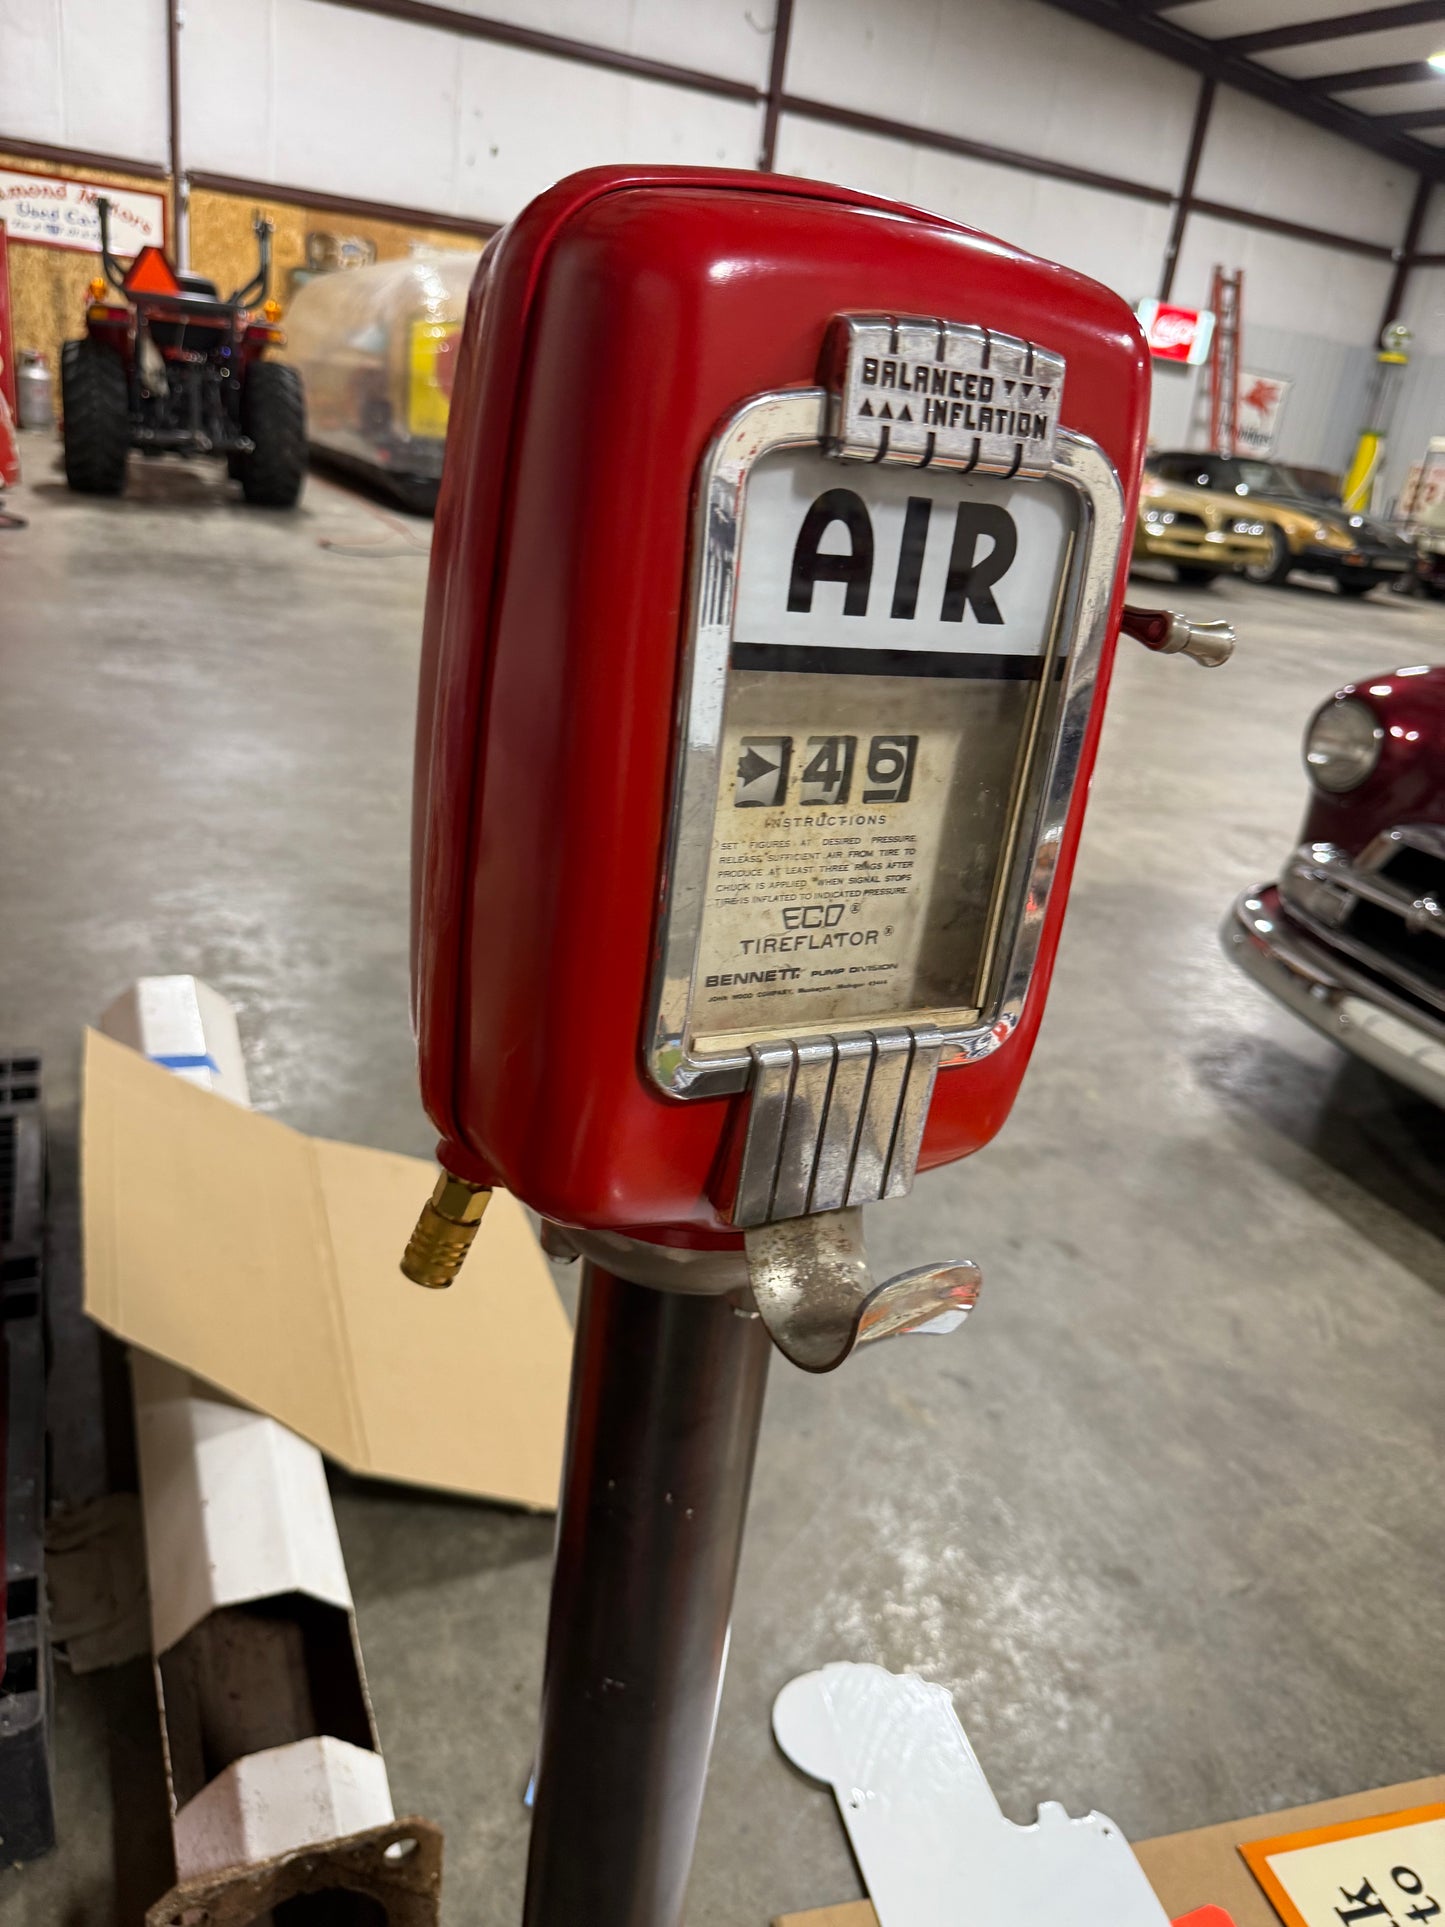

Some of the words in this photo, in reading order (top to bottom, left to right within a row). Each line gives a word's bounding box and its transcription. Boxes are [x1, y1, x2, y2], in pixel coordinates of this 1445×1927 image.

[861, 356, 994, 402] BALANCED
[922, 398, 1047, 440] INFLATION
[786, 488, 1018, 625] AIR
[763, 814, 887, 829] INSTRUCTIONS
[720, 842, 739, 851] SET
[748, 840, 791, 850] FIGURES
[800, 839, 812, 847] AT
[822, 837, 861, 846] DESIRED
[766, 852, 821, 862] SUFFICIENT
[826, 851, 843, 860] AIR
[847, 850, 875, 858] FROM
[879, 848, 900, 857] TIRE
[903, 847, 917, 856] TO
[717, 868, 764, 879] PRODUCE
[768, 867, 782, 877] AT
[785, 866, 815, 875] LEAST
[818, 864, 850, 873] THREE
[885, 860, 915, 870] AFTER
[715, 882, 751, 893] CHUCK
[755, 882, 766, 891] IS
[817, 878, 844, 887] WHEN
[847, 875, 881, 885] SIGNAL
[884, 873, 913, 883] STOPS
[751, 893, 798, 903] INFLATED
[799, 892, 813, 901] TO
[813, 889, 862, 900] INDICATED
[810, 967, 845, 977] PUMP
[847, 962, 899, 974] DIVISION
